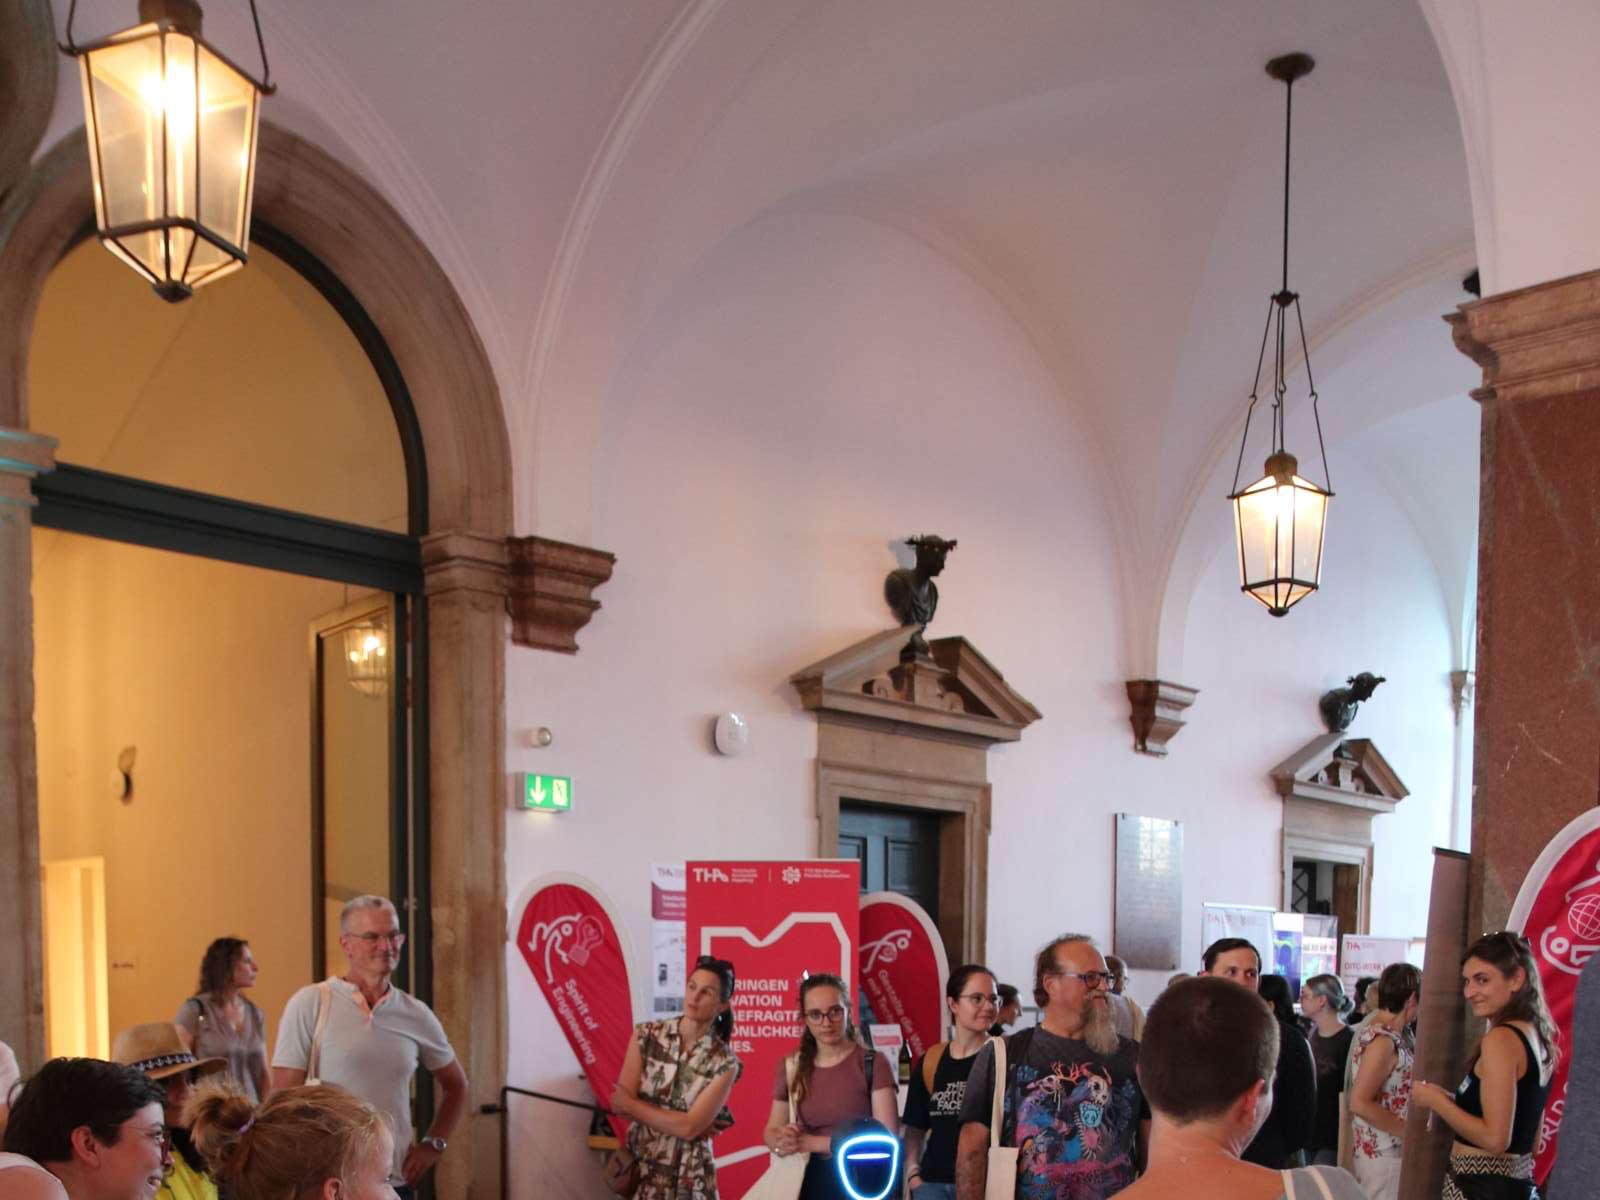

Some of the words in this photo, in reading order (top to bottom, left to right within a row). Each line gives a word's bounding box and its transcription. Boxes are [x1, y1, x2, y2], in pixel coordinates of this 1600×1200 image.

[565, 978, 590, 1017] Spirit
[583, 1015, 600, 1031] of
[731, 994, 783, 1007] VATION
[733, 979, 789, 992] RINGEN
[551, 985, 597, 1065] Engineering
[1535, 1099, 1565, 1157] ORLD
